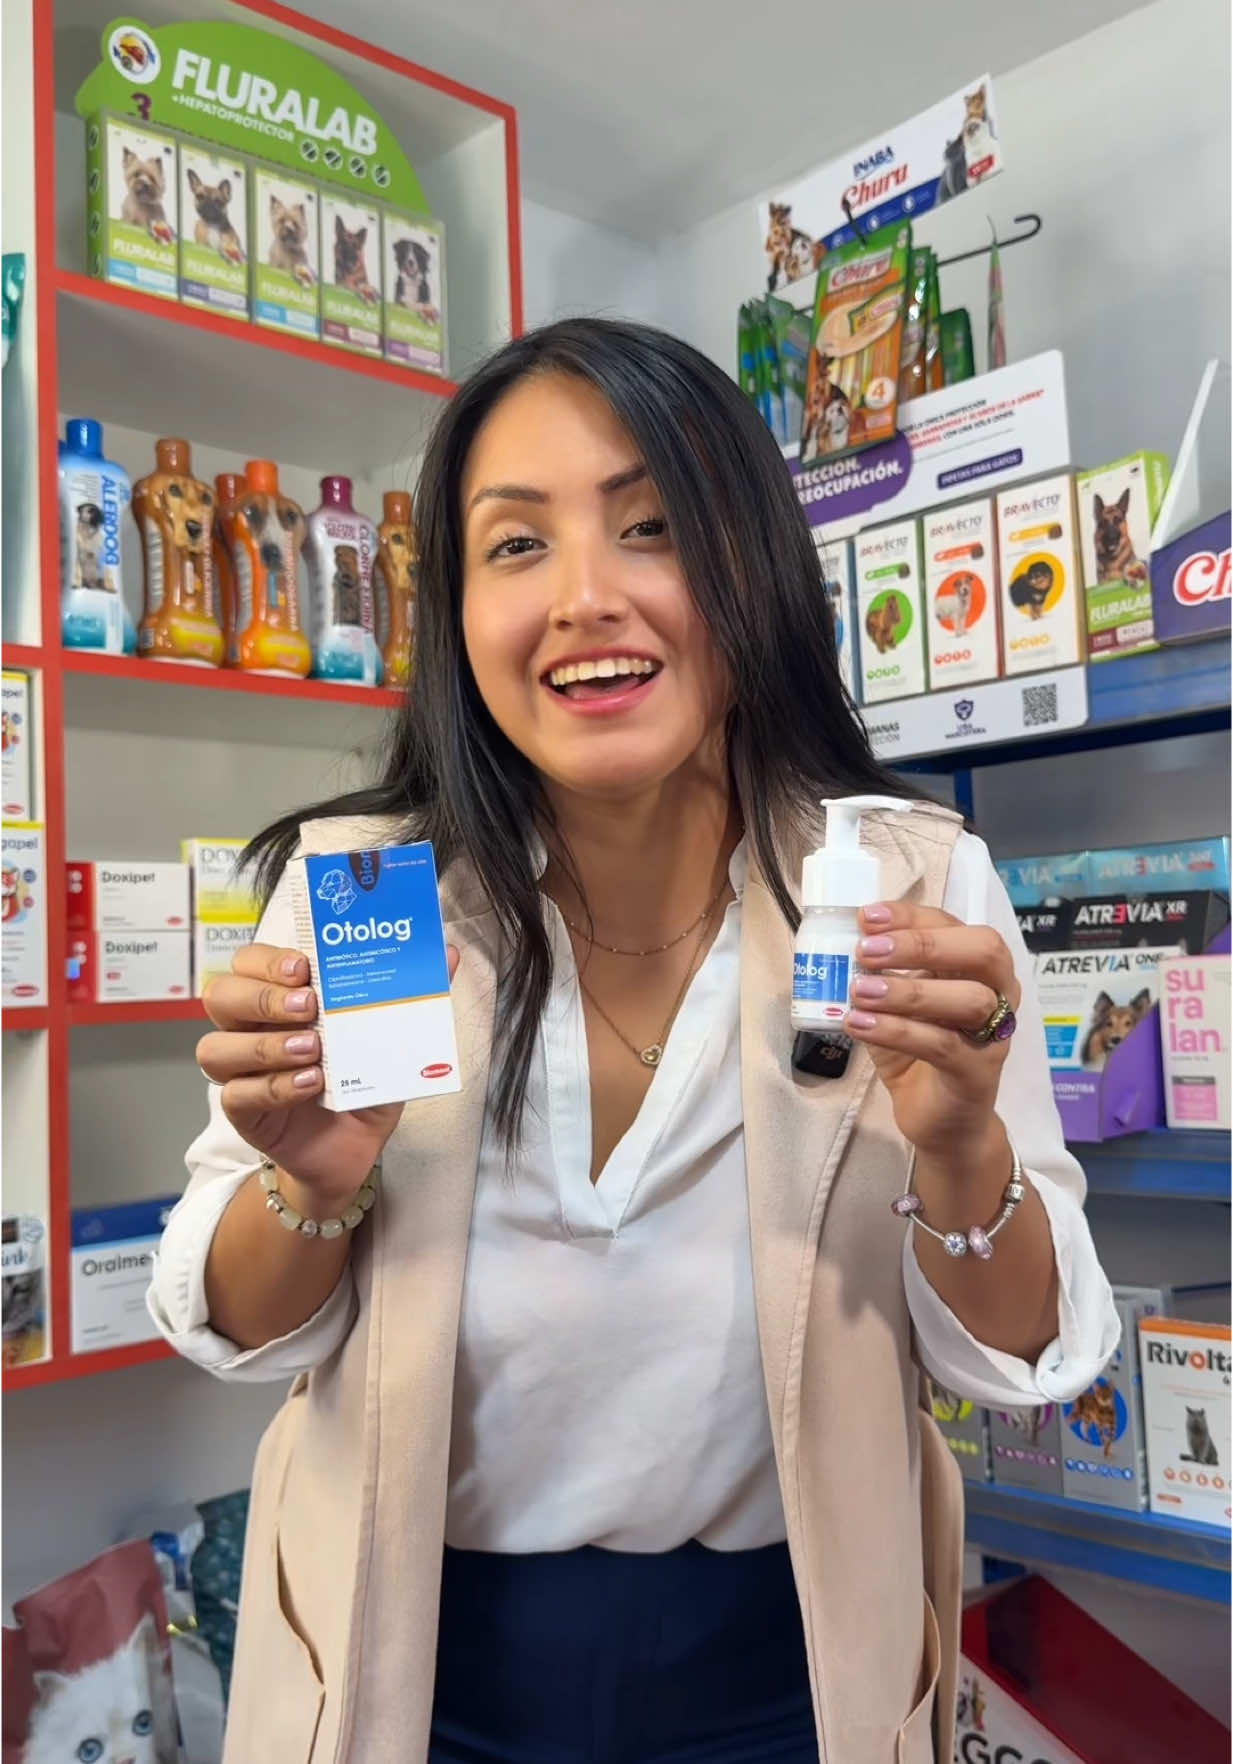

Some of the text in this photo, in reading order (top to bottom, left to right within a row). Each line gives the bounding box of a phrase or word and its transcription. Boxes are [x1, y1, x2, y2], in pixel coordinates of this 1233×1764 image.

[171, 48, 378, 156] FLURALAB
[853, 145, 894, 178] INABA
[840, 162, 909, 211] Churu
[1166, 900, 1188, 915] XR
[321, 917, 411, 946] Otolog
[1041, 953, 1131, 975] ATREVIA
[1165, 969, 1206, 993] su
[1167, 995, 1205, 1020] ra
[1168, 1021, 1222, 1053] lan
